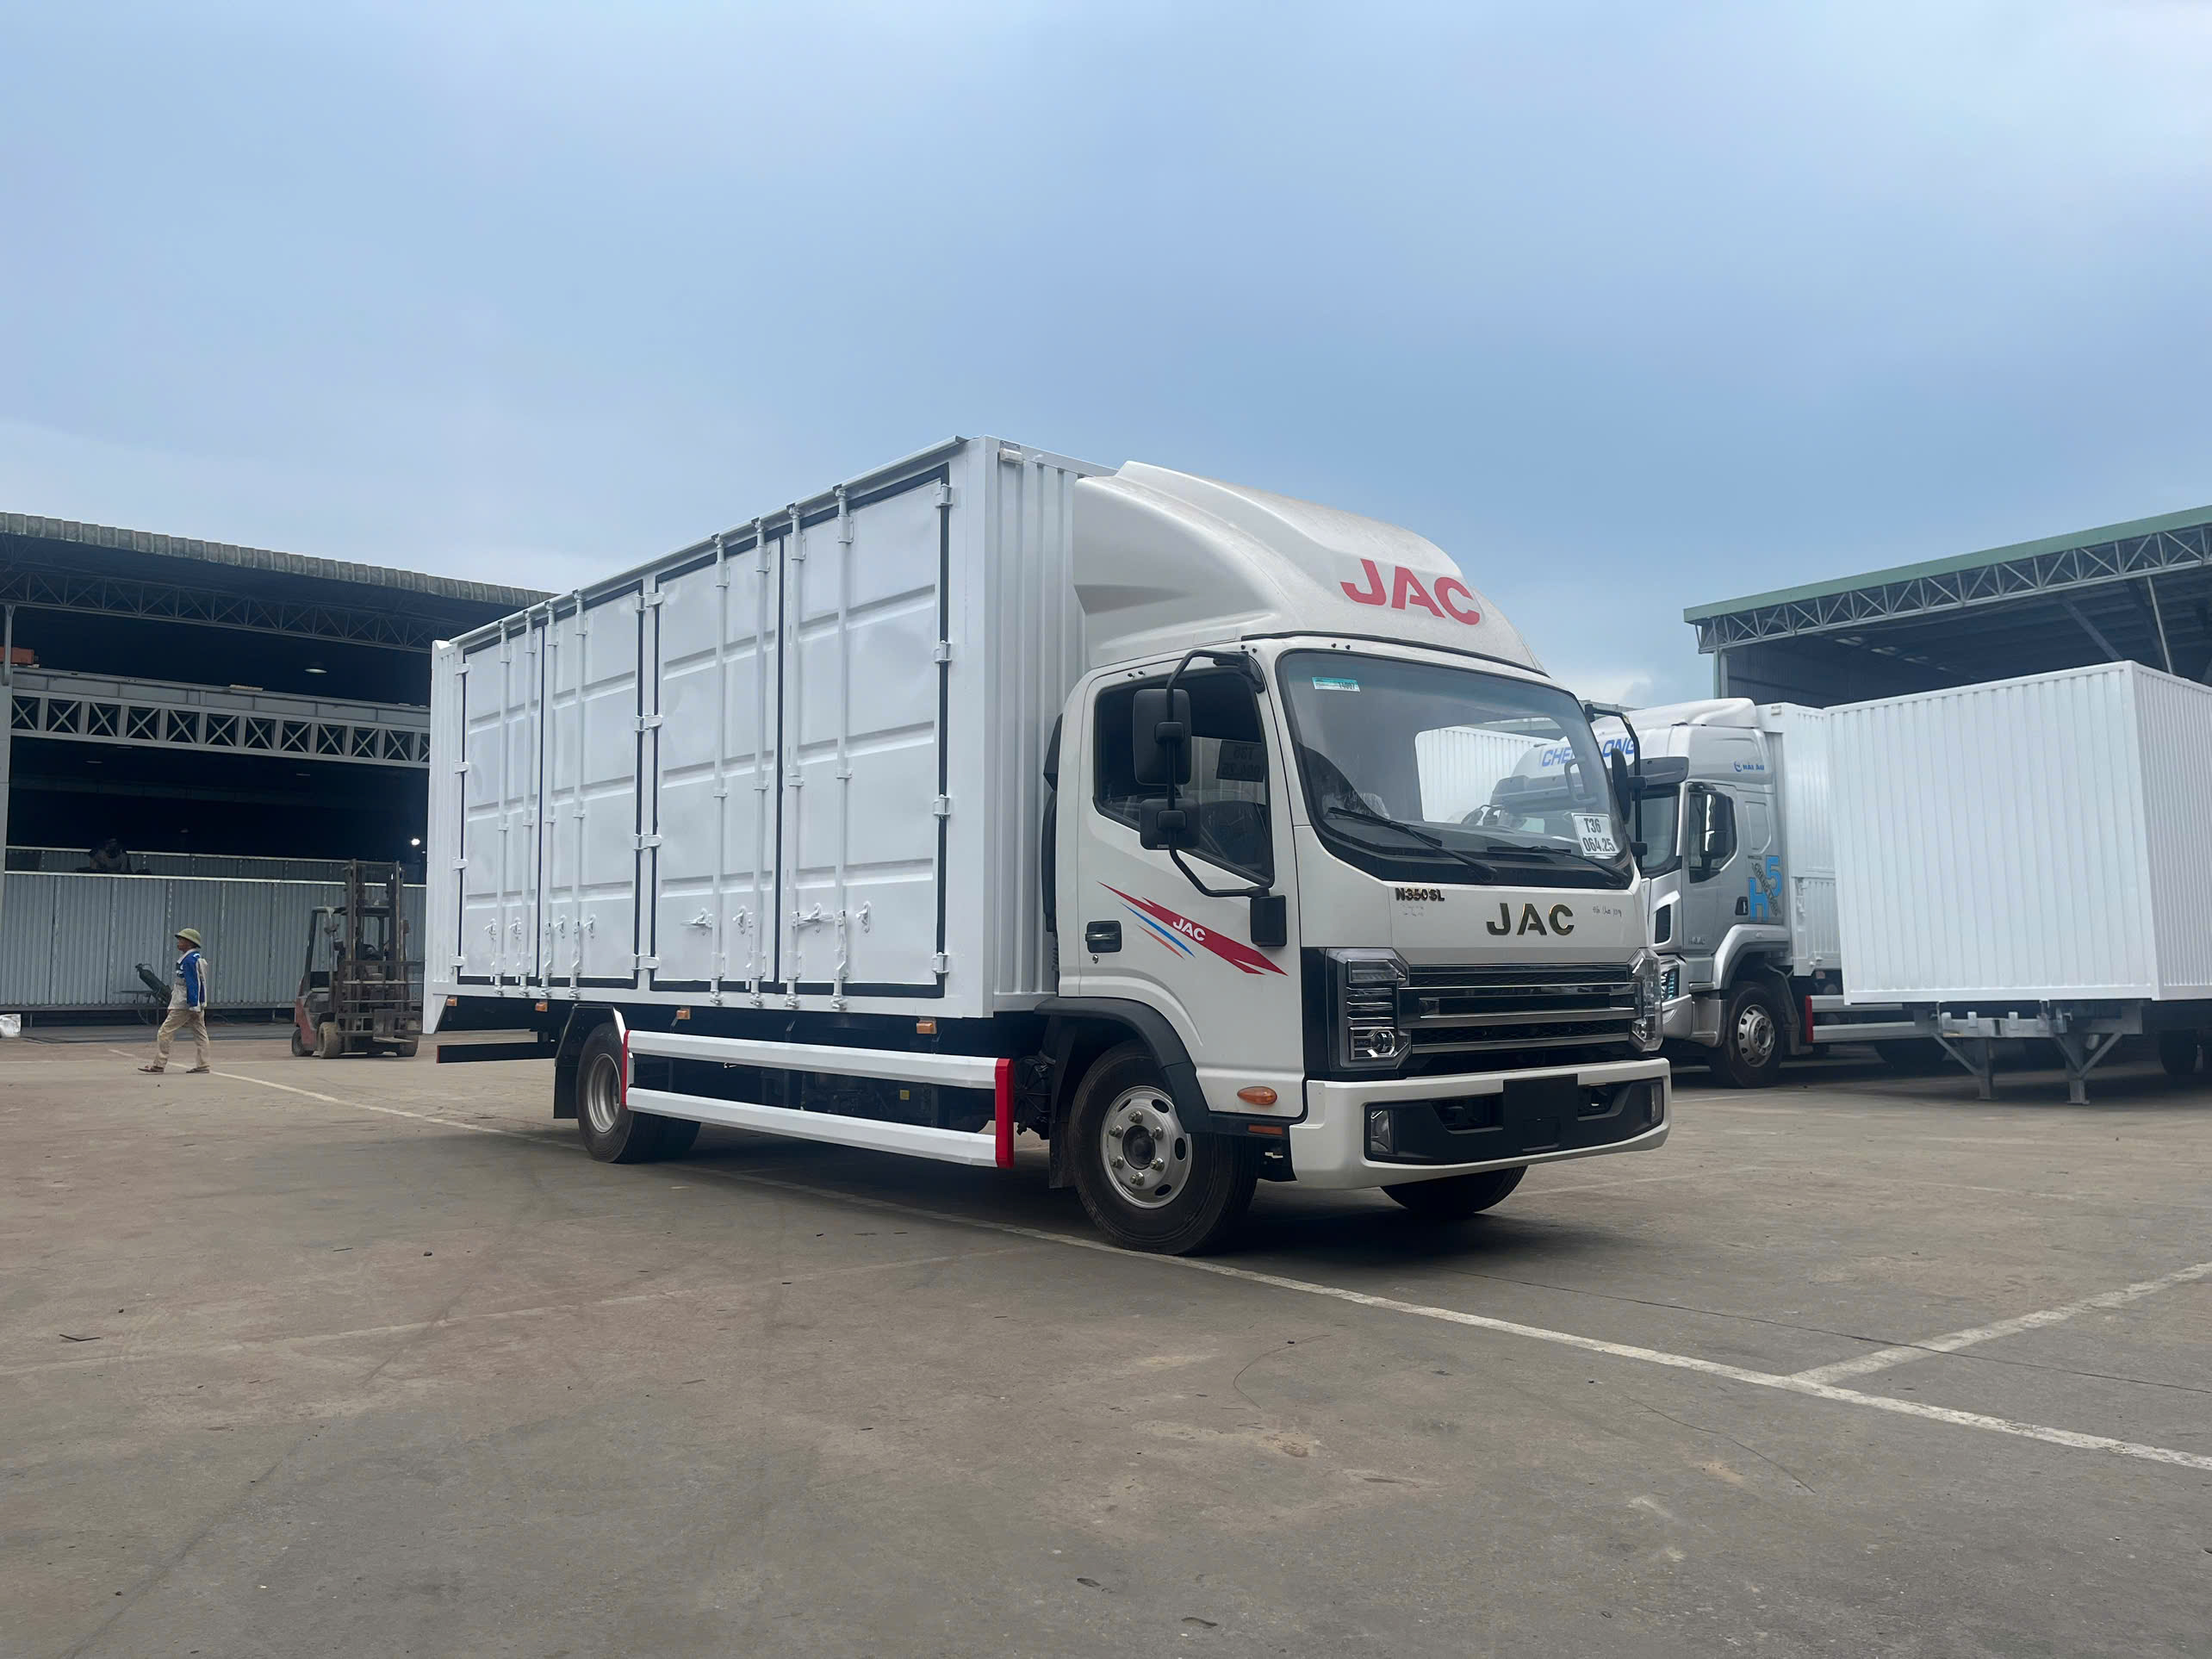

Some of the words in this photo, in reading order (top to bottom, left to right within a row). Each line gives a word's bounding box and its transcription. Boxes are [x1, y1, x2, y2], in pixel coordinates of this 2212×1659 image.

[1340, 558, 1480, 624] JAC
[1584, 817, 1601, 833] T36
[1582, 837, 1616, 852] 064.25
[1395, 887, 1445, 902] N350SL
[1172, 917, 1206, 941] JAC
[1486, 902, 1575, 936] JAC
